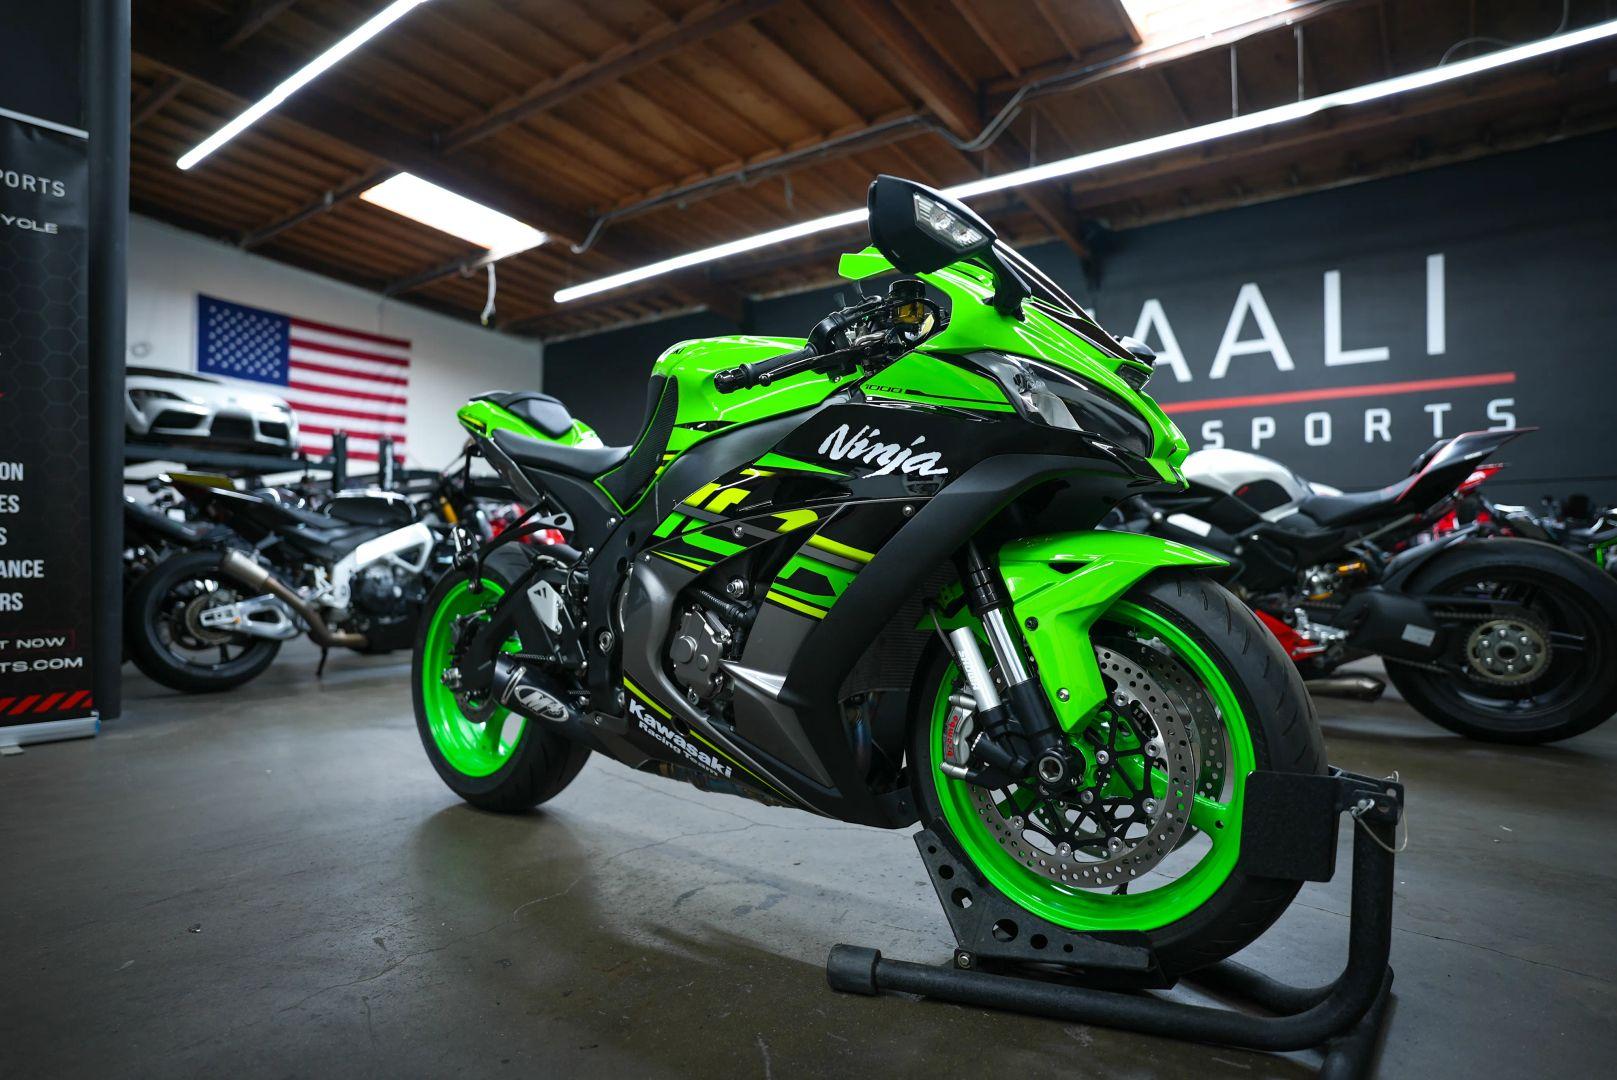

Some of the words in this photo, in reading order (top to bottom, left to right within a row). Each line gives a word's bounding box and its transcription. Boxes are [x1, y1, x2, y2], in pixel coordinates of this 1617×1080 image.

[817, 423, 949, 479] Ninja
[16, 636, 66, 649] NOW
[629, 698, 732, 779] Kawasaki
[638, 720, 681, 754] Racing
